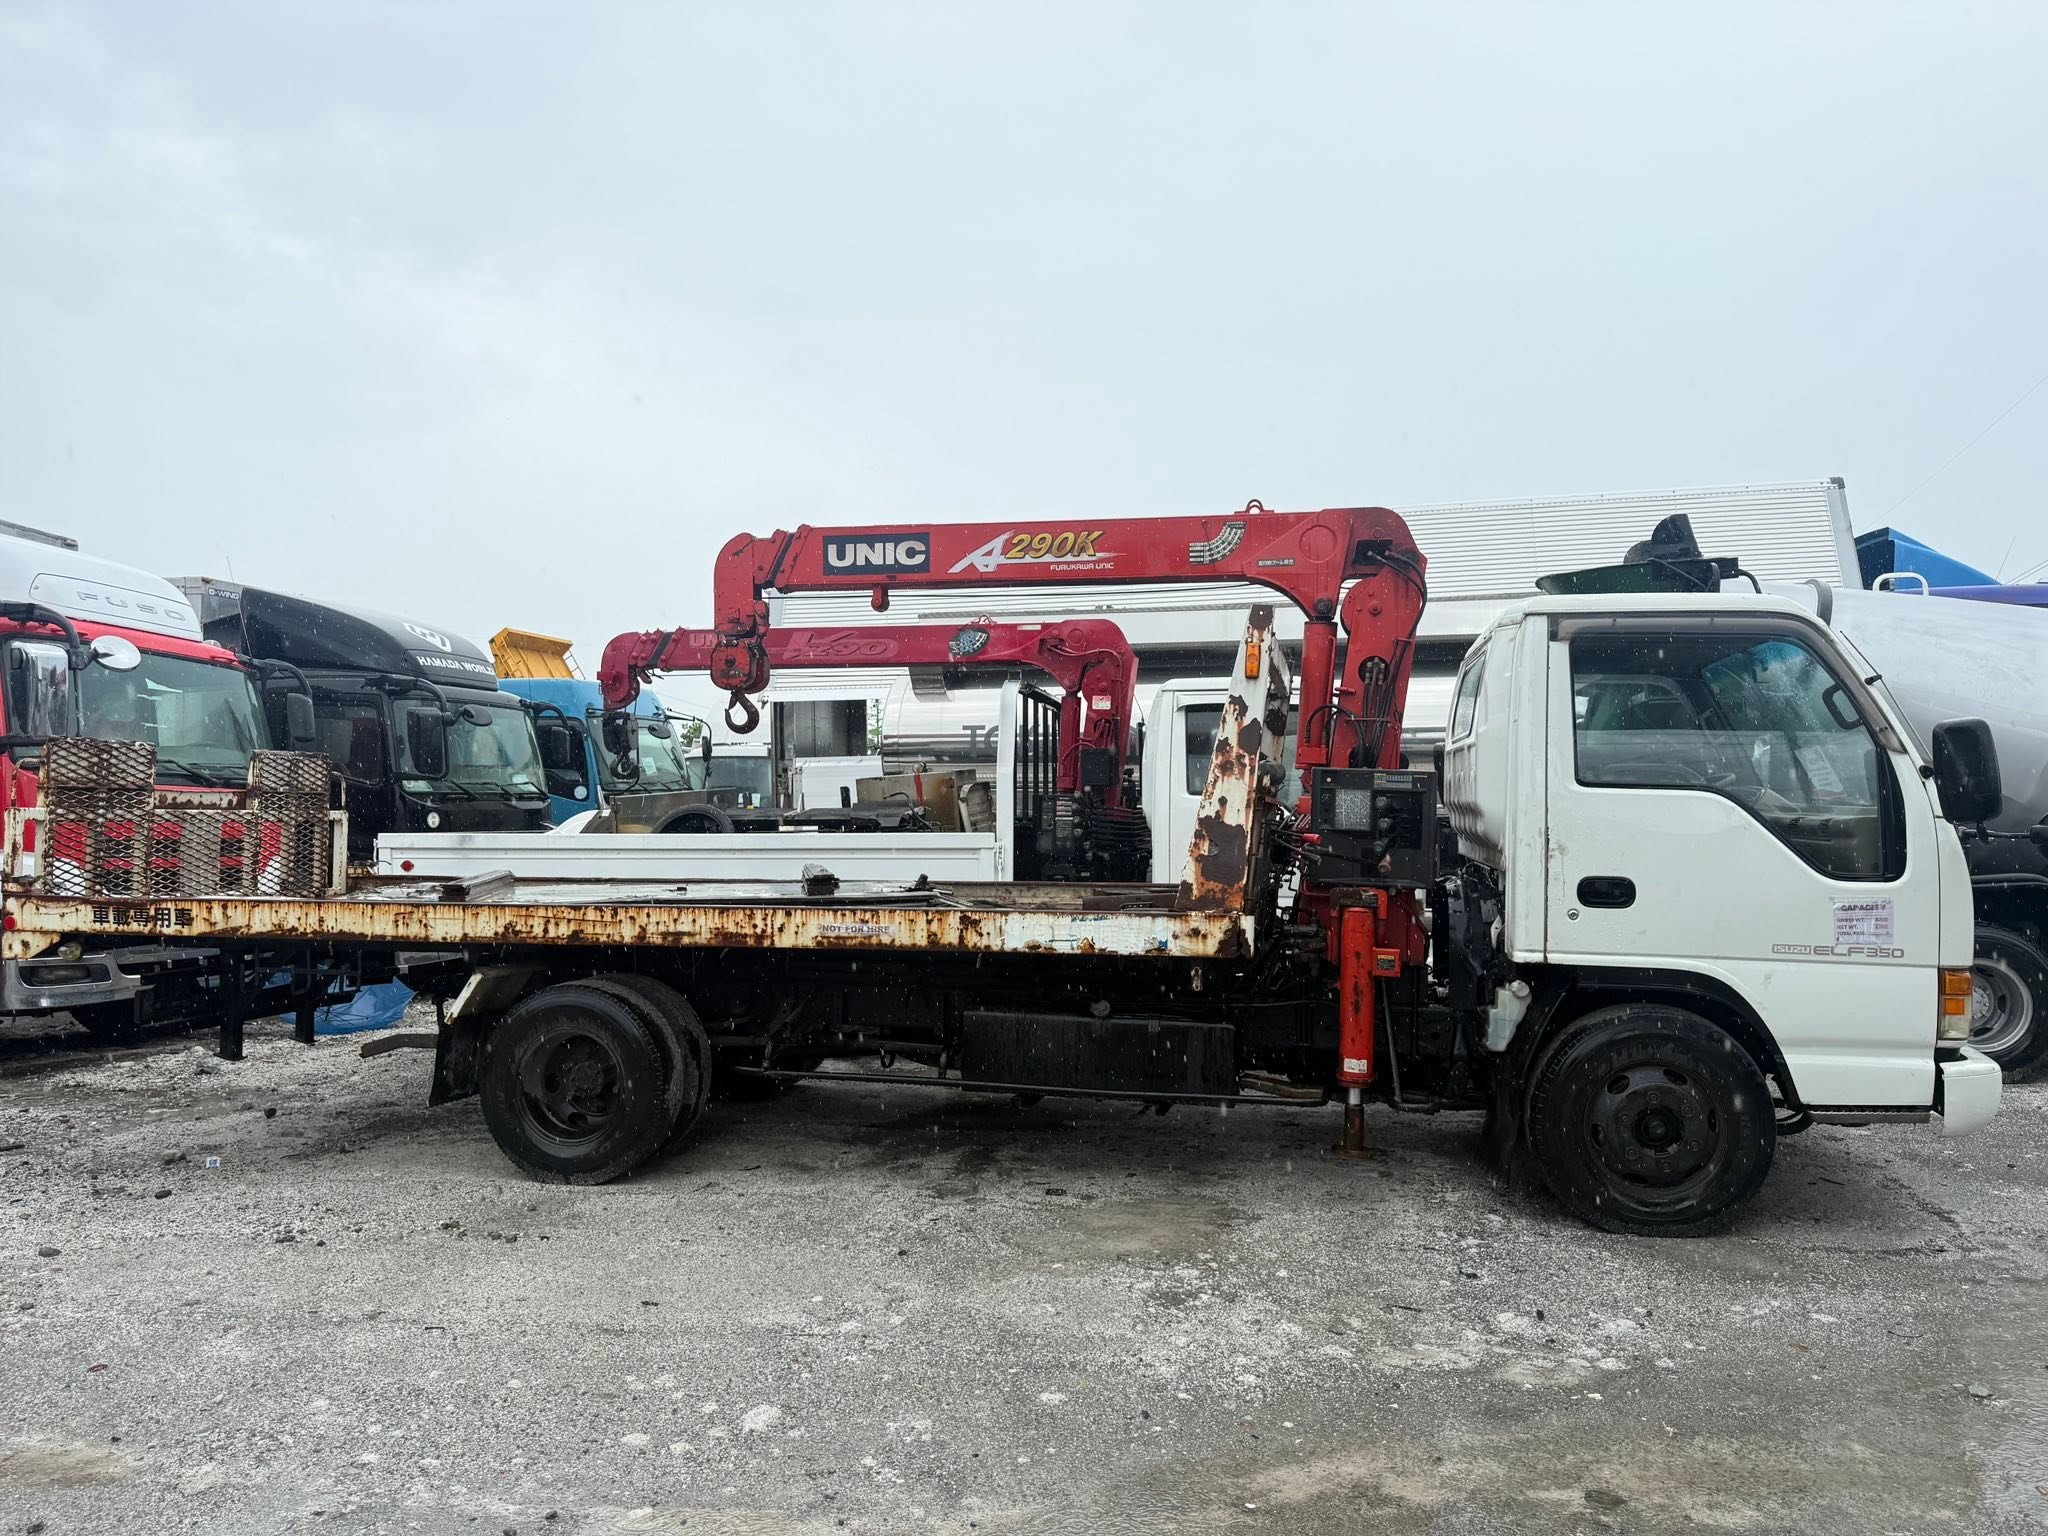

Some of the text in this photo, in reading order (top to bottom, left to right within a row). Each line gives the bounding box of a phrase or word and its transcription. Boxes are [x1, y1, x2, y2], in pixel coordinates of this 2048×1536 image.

[827, 539, 926, 567] UNIC
[1095, 562, 1115, 570] UNIC
[76, 591, 186, 622] FUSO
[416, 655, 496, 675] HAMADA WORLD
[822, 924, 890, 933] NOT FOR HIRE
[1773, 944, 1810, 953] ISUZU
